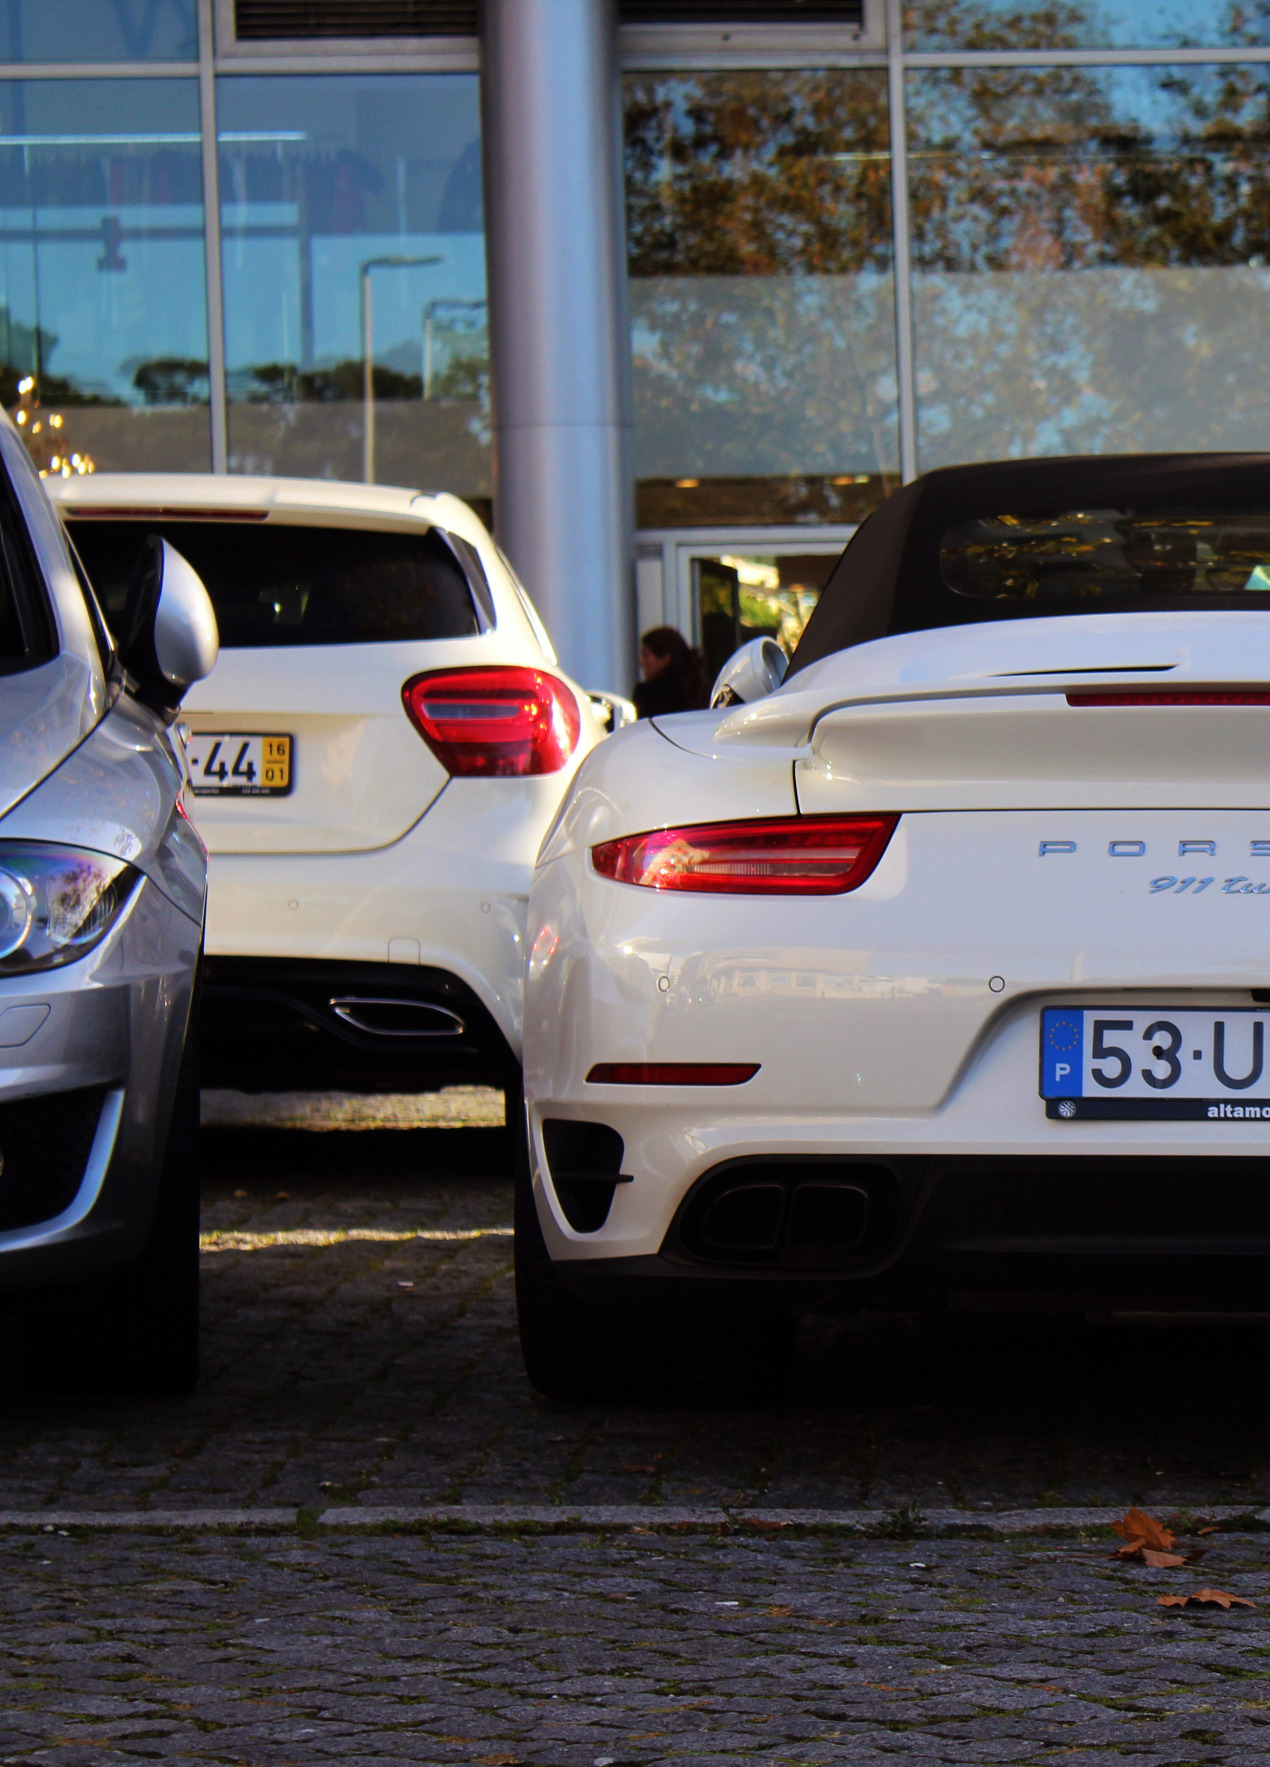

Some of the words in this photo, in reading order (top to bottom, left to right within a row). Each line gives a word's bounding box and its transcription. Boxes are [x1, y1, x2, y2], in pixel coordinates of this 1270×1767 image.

[268, 742, 286, 756] 16
[265, 768, 285, 782] 01
[1149, 875, 1215, 895] 911
[1055, 1063, 1071, 1082] P
